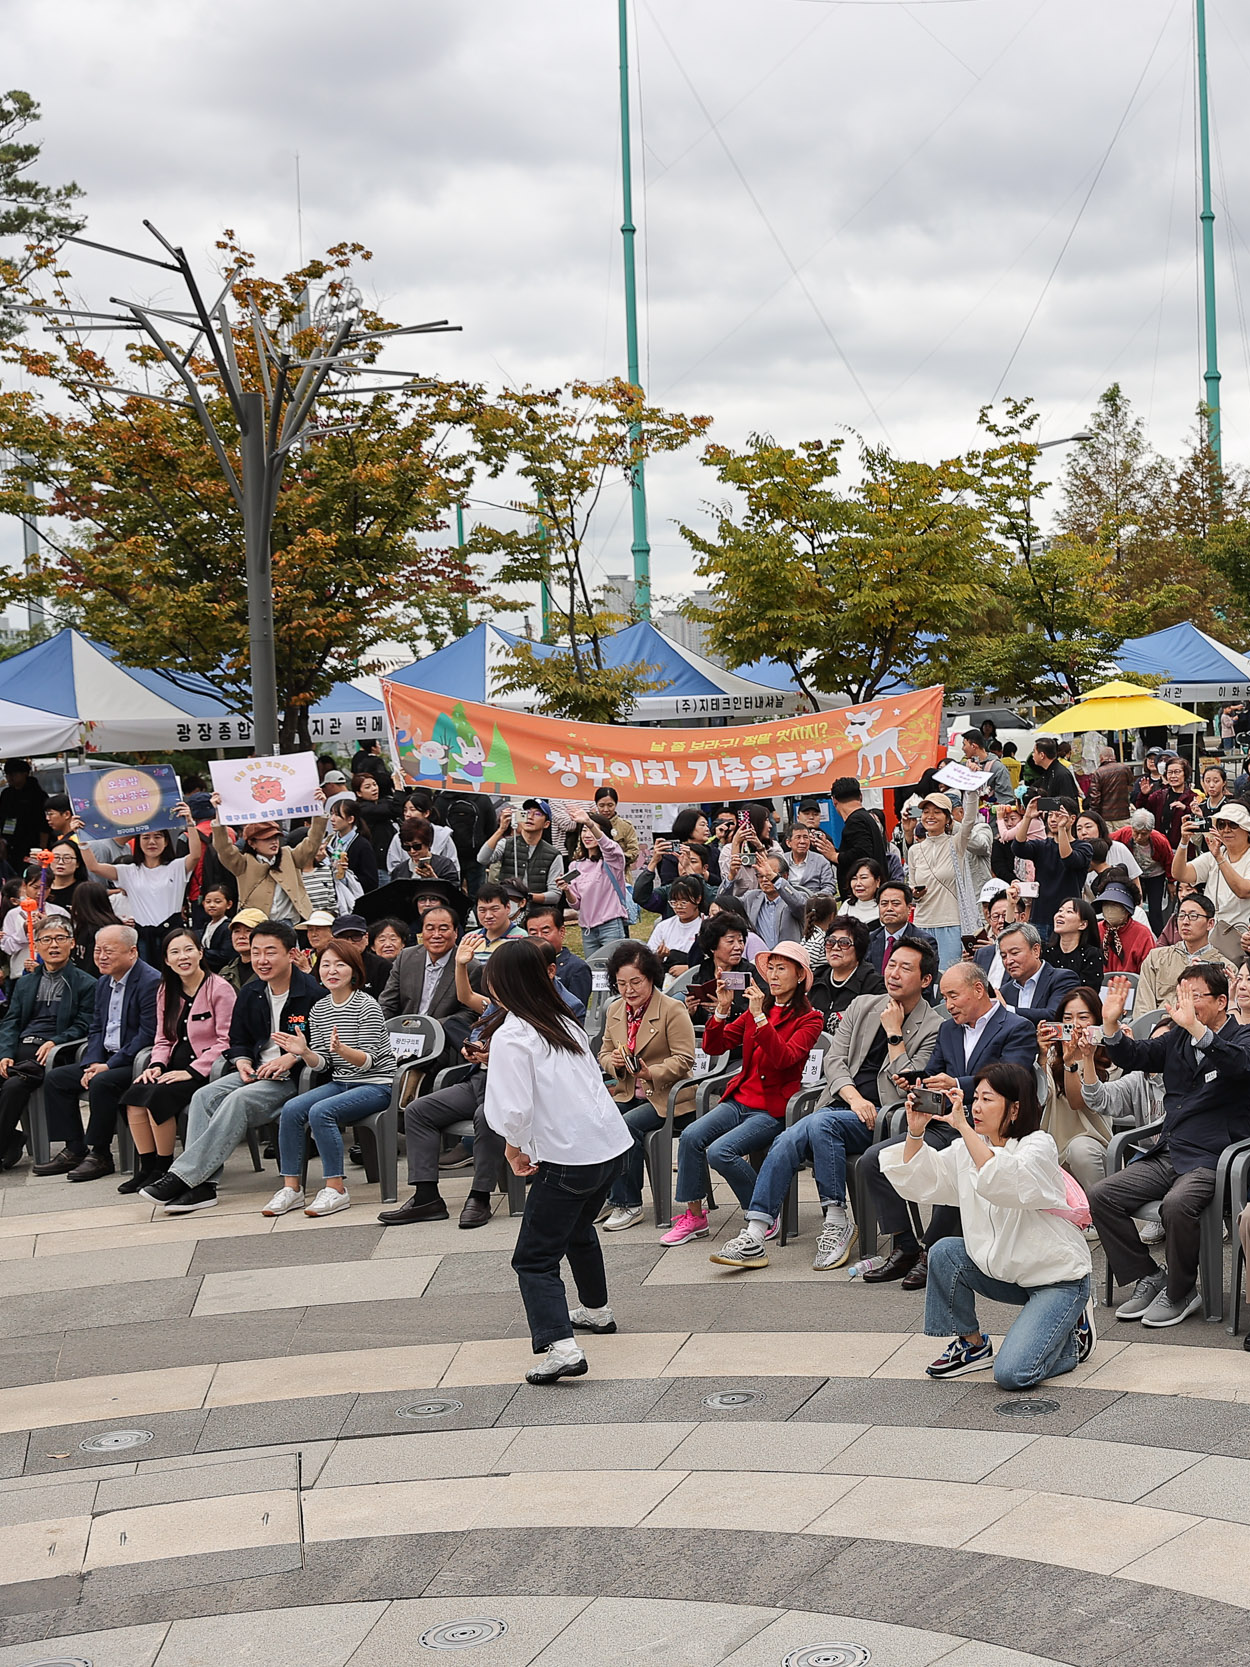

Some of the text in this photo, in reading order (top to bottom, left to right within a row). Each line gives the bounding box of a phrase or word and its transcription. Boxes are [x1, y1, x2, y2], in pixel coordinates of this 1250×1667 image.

[650, 741, 667, 752] 날
[690, 737, 741, 751] 보라구!
[743, 732, 773, 746] 정말
[776, 721, 829, 743] 멋지지?
[545, 748, 834, 792] 청구이화 가족운동회
[108, 776, 138, 789] 오늘밤
[108, 789, 149, 803] 주인공은
[112, 803, 151, 816] 나야 나!
